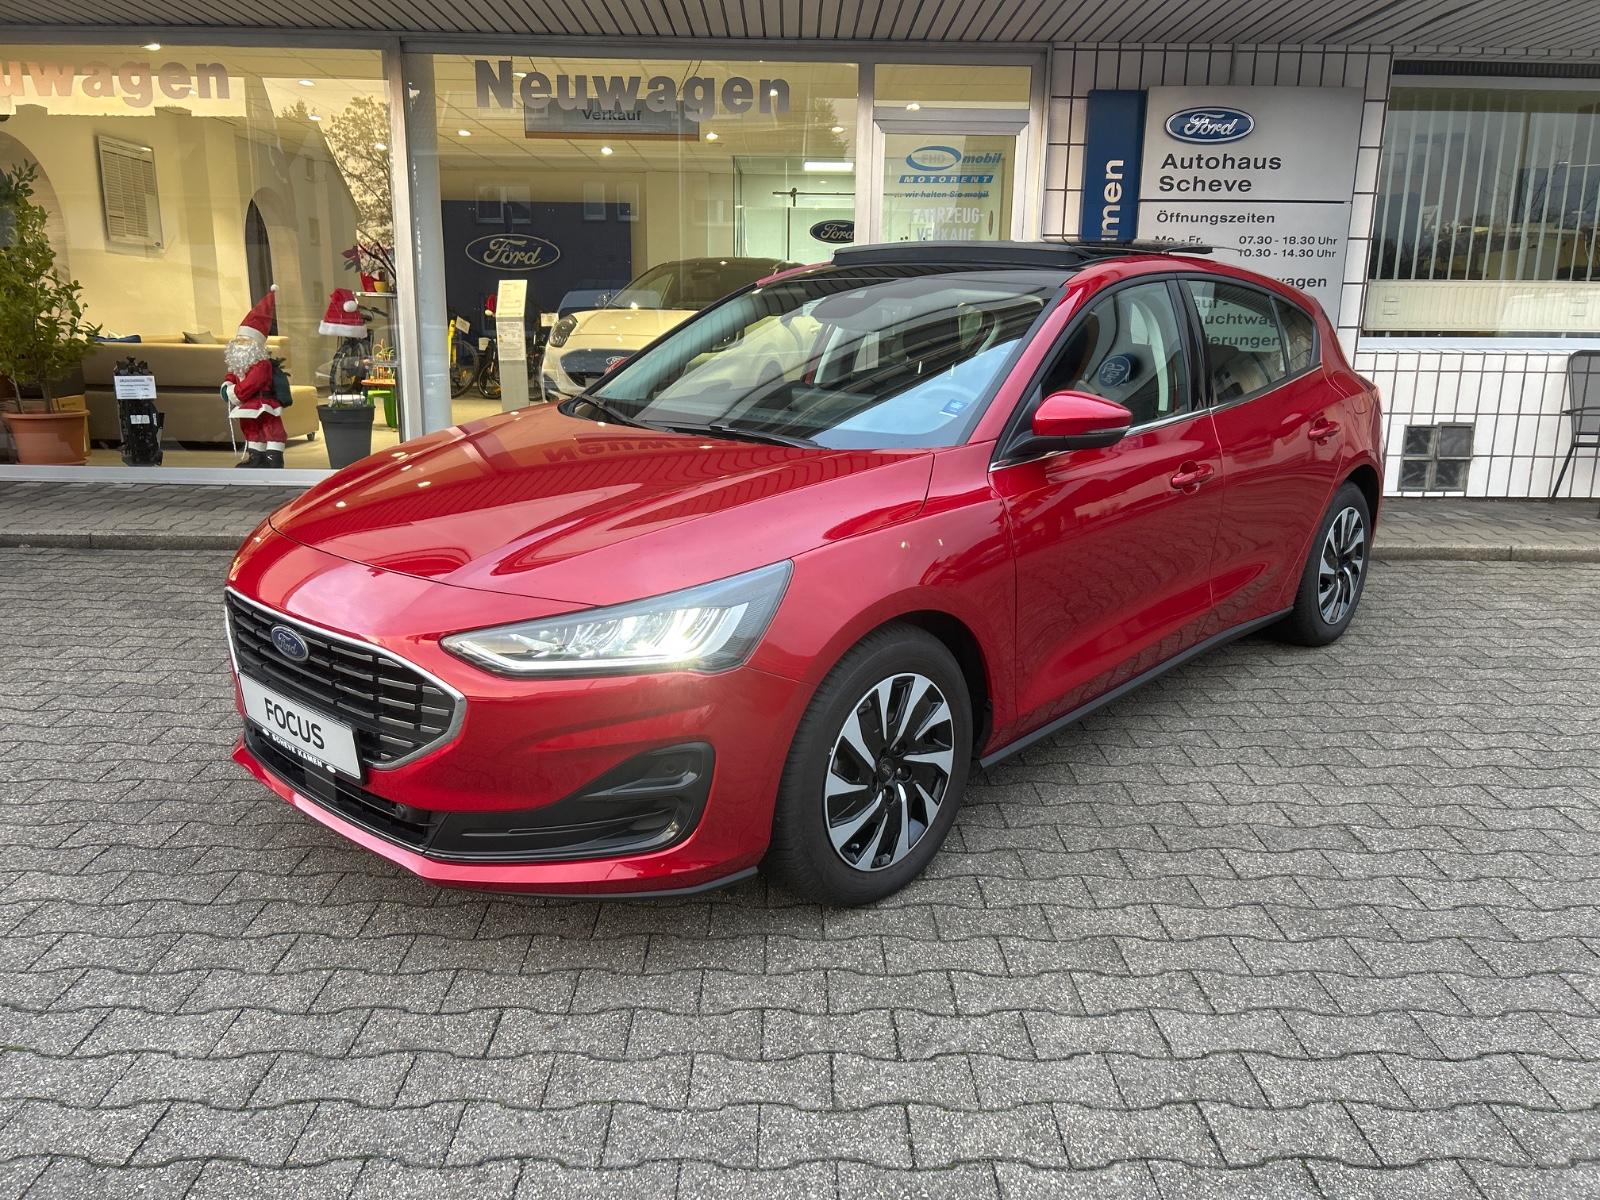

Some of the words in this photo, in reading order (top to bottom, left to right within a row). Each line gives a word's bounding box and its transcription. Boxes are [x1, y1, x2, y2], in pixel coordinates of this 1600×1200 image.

[474, 60, 790, 122] Neuwagen
[582, 109, 642, 121] Verkauf
[1184, 113, 1238, 136] Ford
[962, 152, 1002, 164] mobil
[1161, 153, 1282, 170] Autohaus
[904, 175, 991, 183] MOTORENT
[1159, 175, 1252, 192] Scheve
[905, 191, 919, 199] wir
[921, 190, 947, 199] halten
[949, 190, 962, 199] Sie
[1101, 160, 1124, 241] men
[1156, 210, 1275, 226] Öffnungszeiten
[1238, 236, 1272, 246] 07.30
[1283, 236, 1315, 246] 18.30
[1318, 236, 1338, 246] Uhr
[1239, 248, 1271, 258] 10.30
[1281, 248, 1313, 258] 14.30
[1316, 249, 1336, 258] Uhr
[1278, 277, 1327, 291] agen
[264, 697, 325, 750] FOCUS
